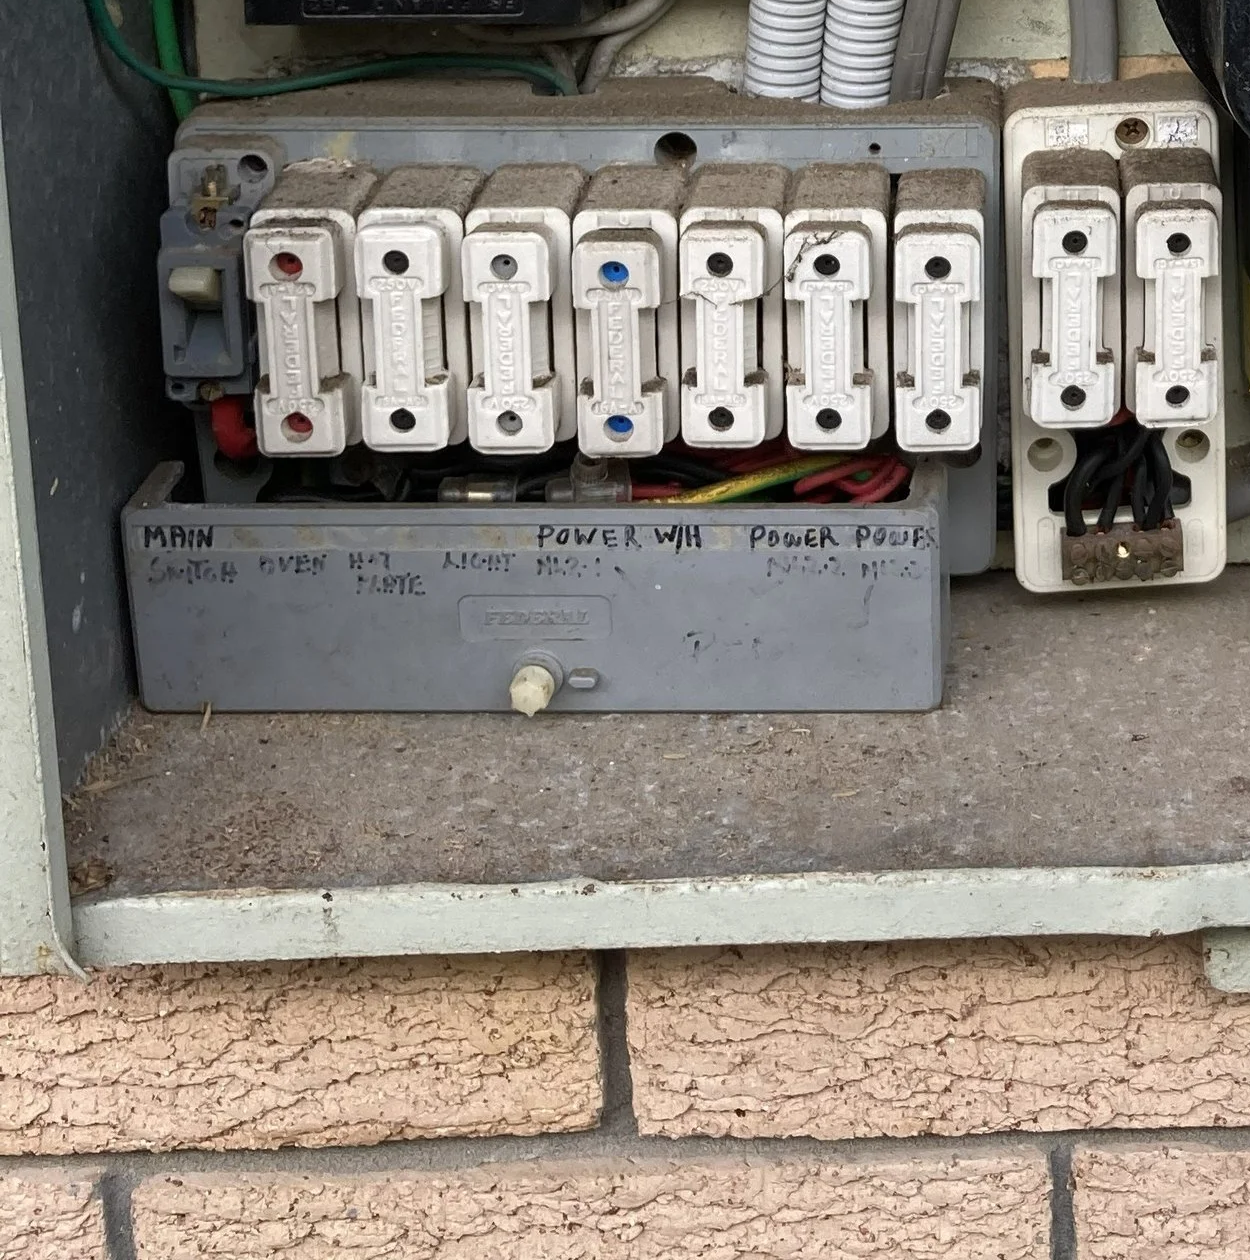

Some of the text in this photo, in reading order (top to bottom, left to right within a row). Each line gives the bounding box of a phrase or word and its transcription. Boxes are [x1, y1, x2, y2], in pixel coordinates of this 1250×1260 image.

[144, 525, 214, 550] MAIN
[537, 525, 643, 550] POWER
[750, 525, 840, 549] POWER
